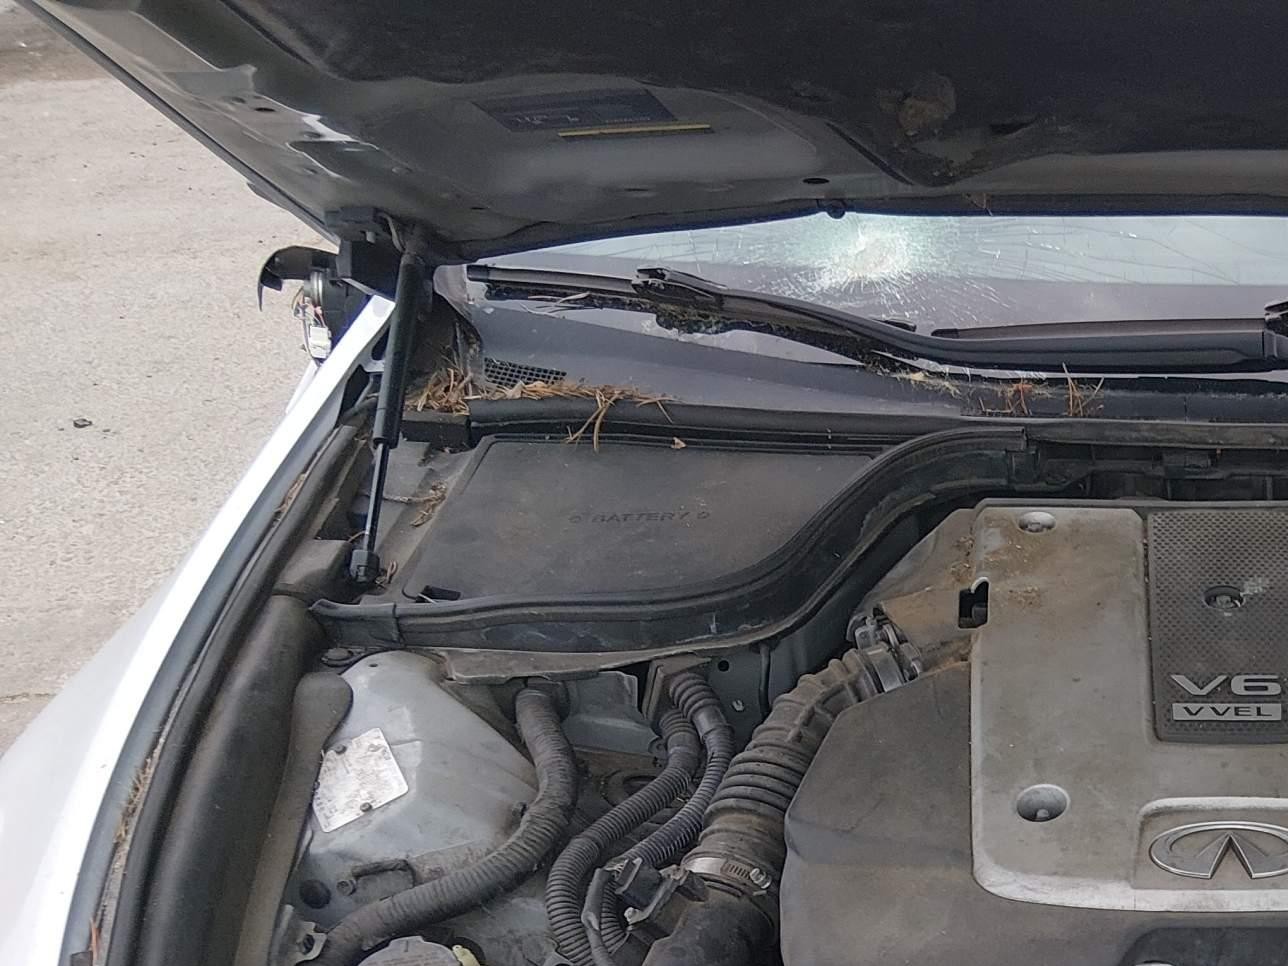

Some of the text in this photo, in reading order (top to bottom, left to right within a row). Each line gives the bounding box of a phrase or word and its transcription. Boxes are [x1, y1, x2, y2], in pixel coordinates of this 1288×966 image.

[592, 511, 690, 524] BATTERY
[1169, 674, 1282, 696] V6
[1183, 706, 1273, 717] VVEL
